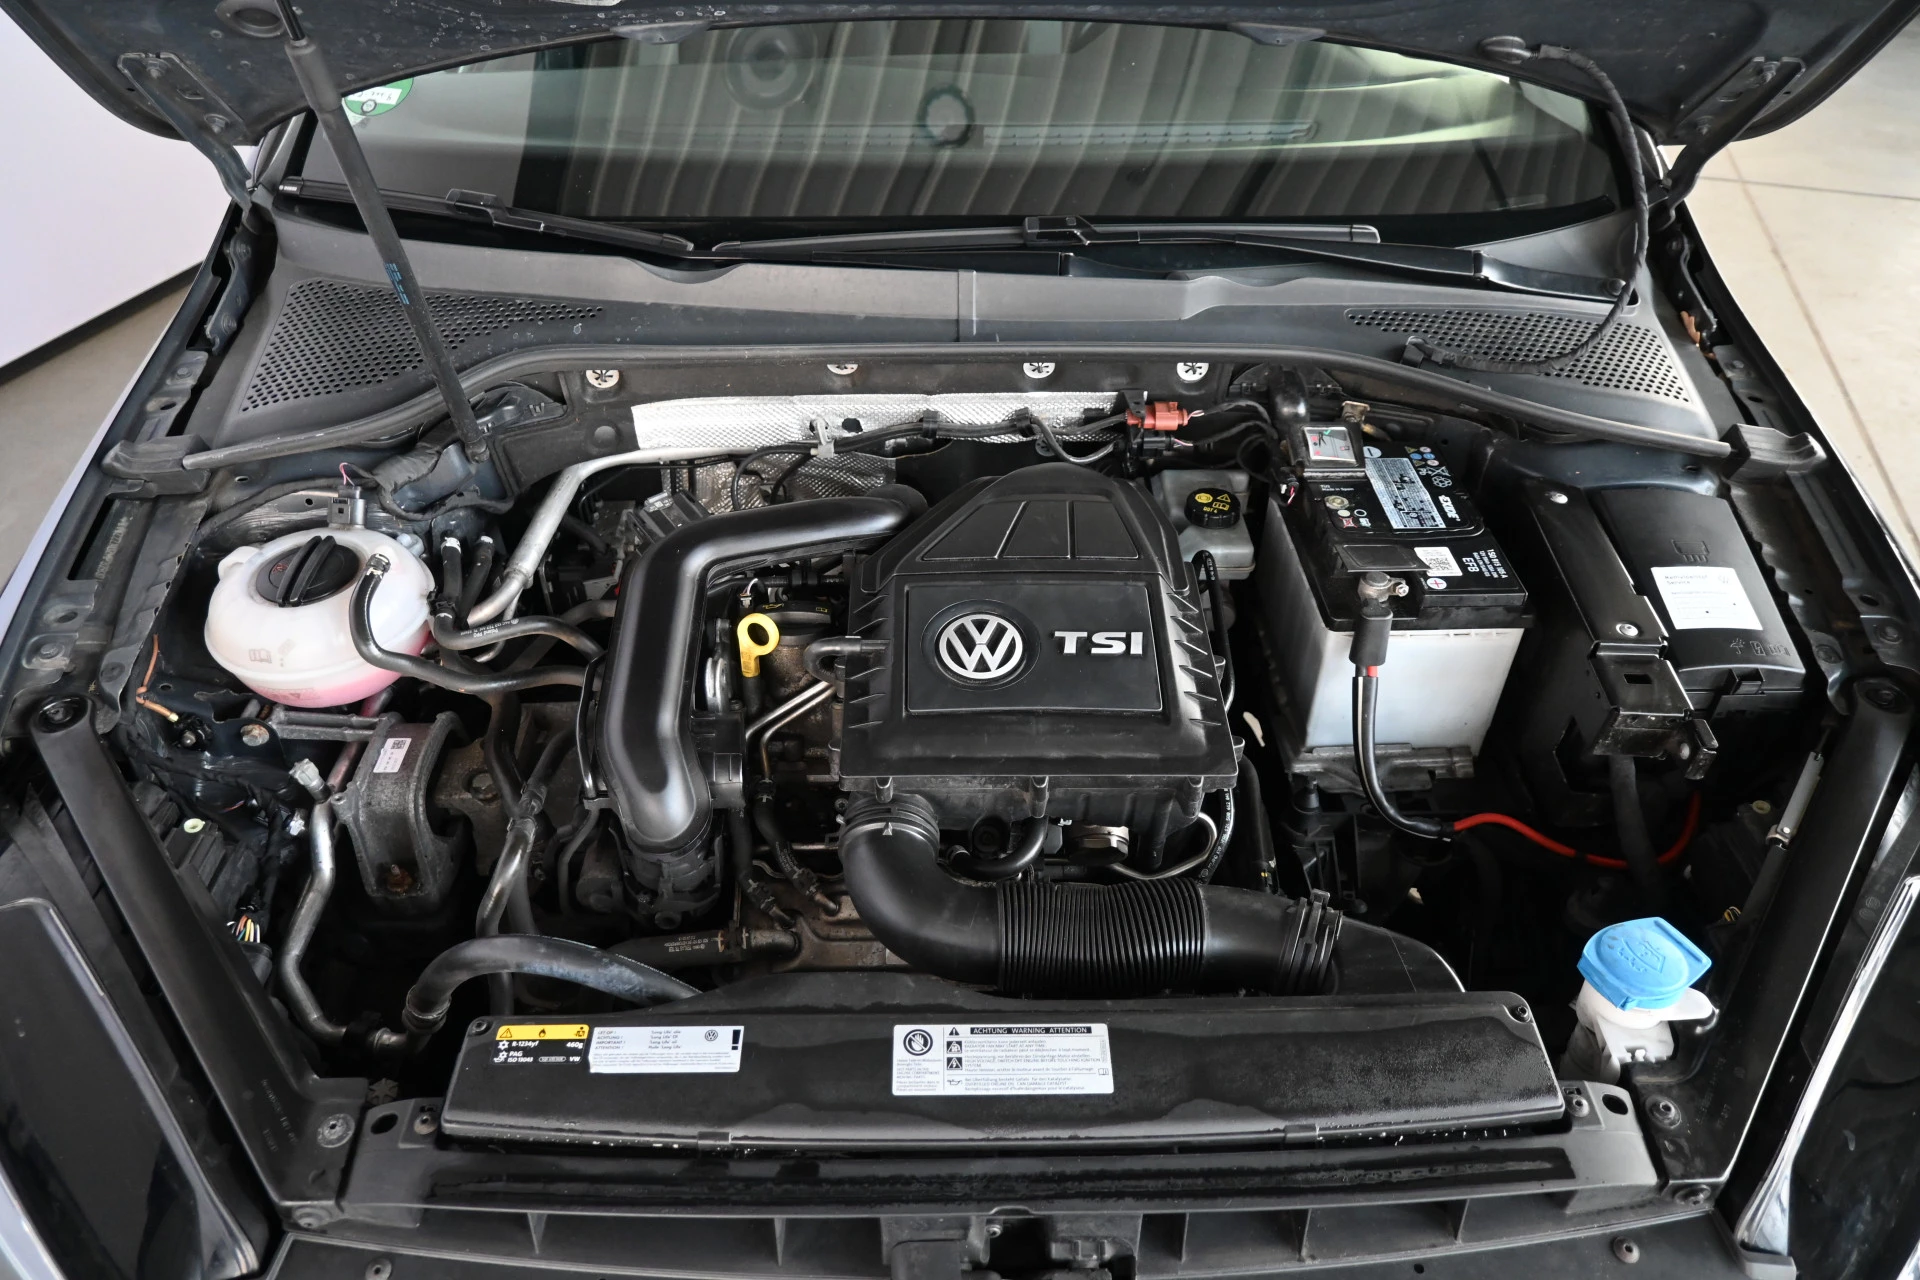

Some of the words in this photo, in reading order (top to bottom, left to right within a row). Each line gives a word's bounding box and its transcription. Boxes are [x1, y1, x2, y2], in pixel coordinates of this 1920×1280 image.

[1462, 557, 1480, 573] EFB
[939, 613, 1023, 680] VW
[1054, 631, 1143, 655] TSI
[566, 1041, 583, 1049] 460g
